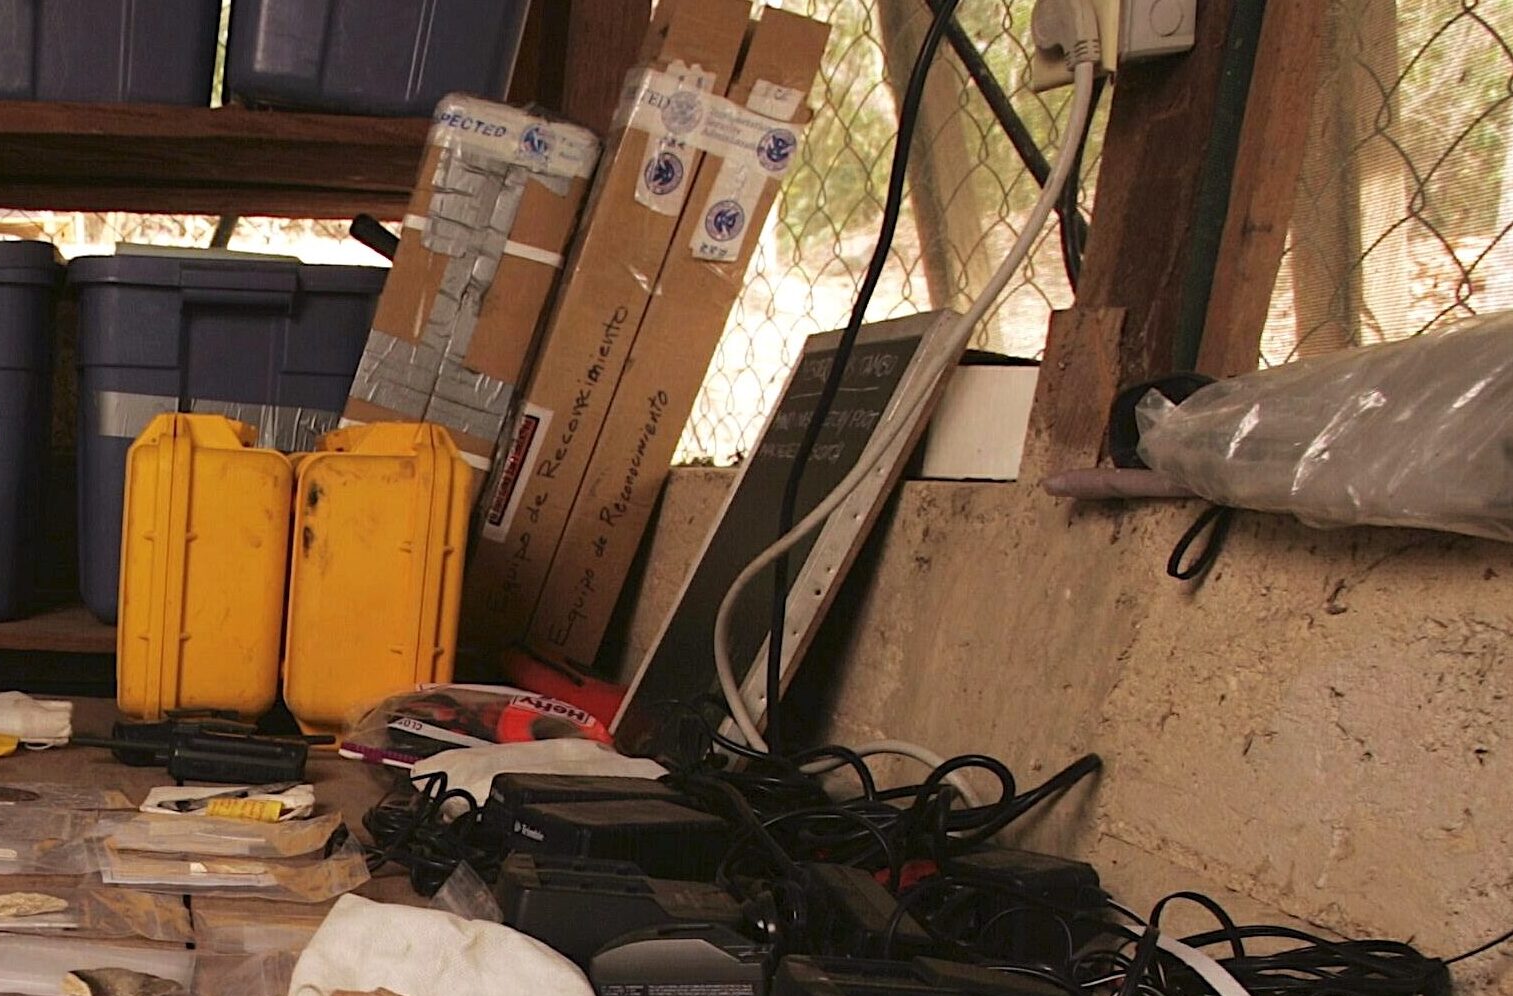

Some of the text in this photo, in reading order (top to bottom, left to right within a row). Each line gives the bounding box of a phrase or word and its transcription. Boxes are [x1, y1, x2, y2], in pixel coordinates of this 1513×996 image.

[530, 492, 548, 524] de
[548, 568, 596, 647] Equipo
[594, 534, 608, 558] de
[520, 694, 586, 721] Hefty
